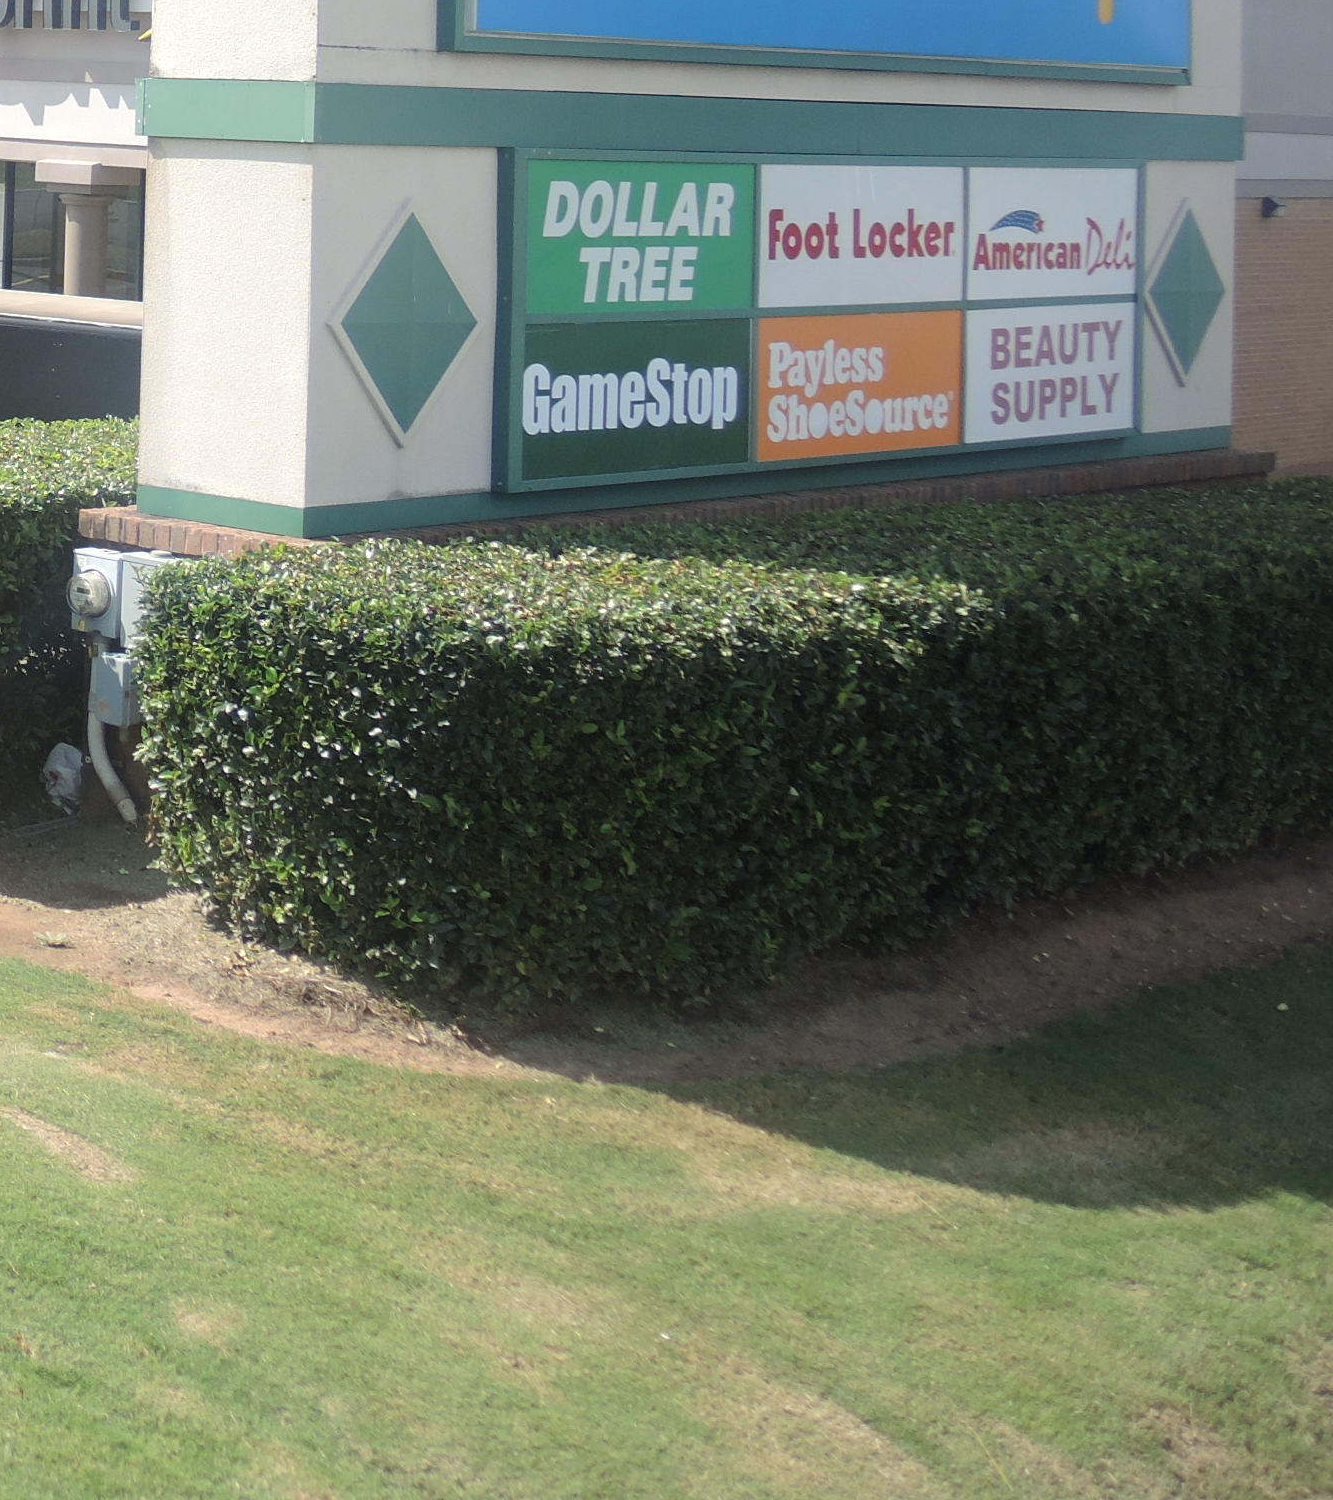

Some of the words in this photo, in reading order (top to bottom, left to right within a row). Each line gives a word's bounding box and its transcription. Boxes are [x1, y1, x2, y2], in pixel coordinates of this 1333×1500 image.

[541, 179, 736, 240] DOLLAR
[768, 207, 840, 261] Foot
[852, 207, 955, 259] Locker
[577, 246, 699, 304] TREE
[972, 233, 1083, 271] American
[1085, 216, 1136, 277] Deli
[767, 338, 884, 398] Payless
[989, 319, 1124, 371] BEAUTY
[522, 357, 739, 436] GameStop
[766, 389, 950, 443] ShoeSource
[989, 371, 1121, 426] SUPPLY
